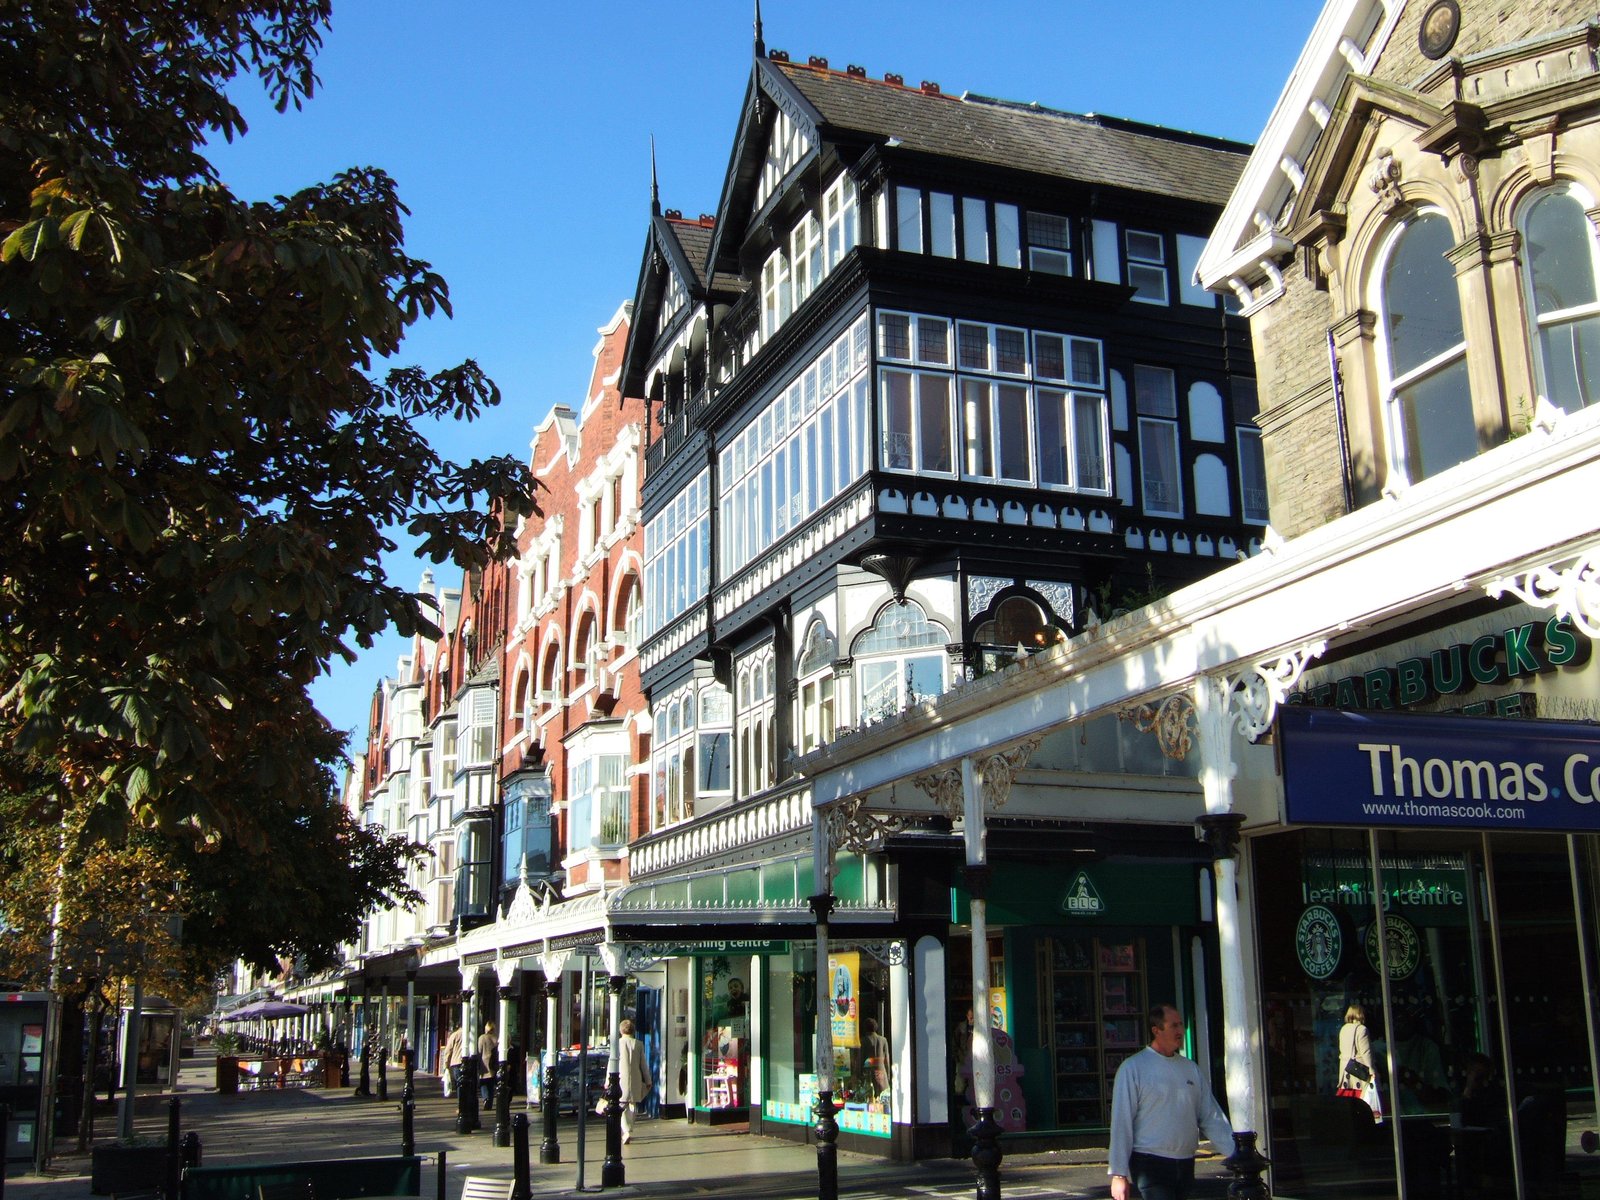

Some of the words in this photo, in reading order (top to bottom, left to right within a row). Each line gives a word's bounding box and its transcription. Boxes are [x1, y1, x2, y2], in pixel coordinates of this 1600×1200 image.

[1358, 744, 1548, 801] Thomas
[1363, 801, 1525, 819] www.thomascook.com
[1070, 898, 1097, 909] ELC
[1401, 886, 1463, 905] centre
[1298, 908, 1339, 942] STARBUCKS
[1304, 954, 1336, 975] COFFEE
[1375, 960, 1415, 977] CFFEE
